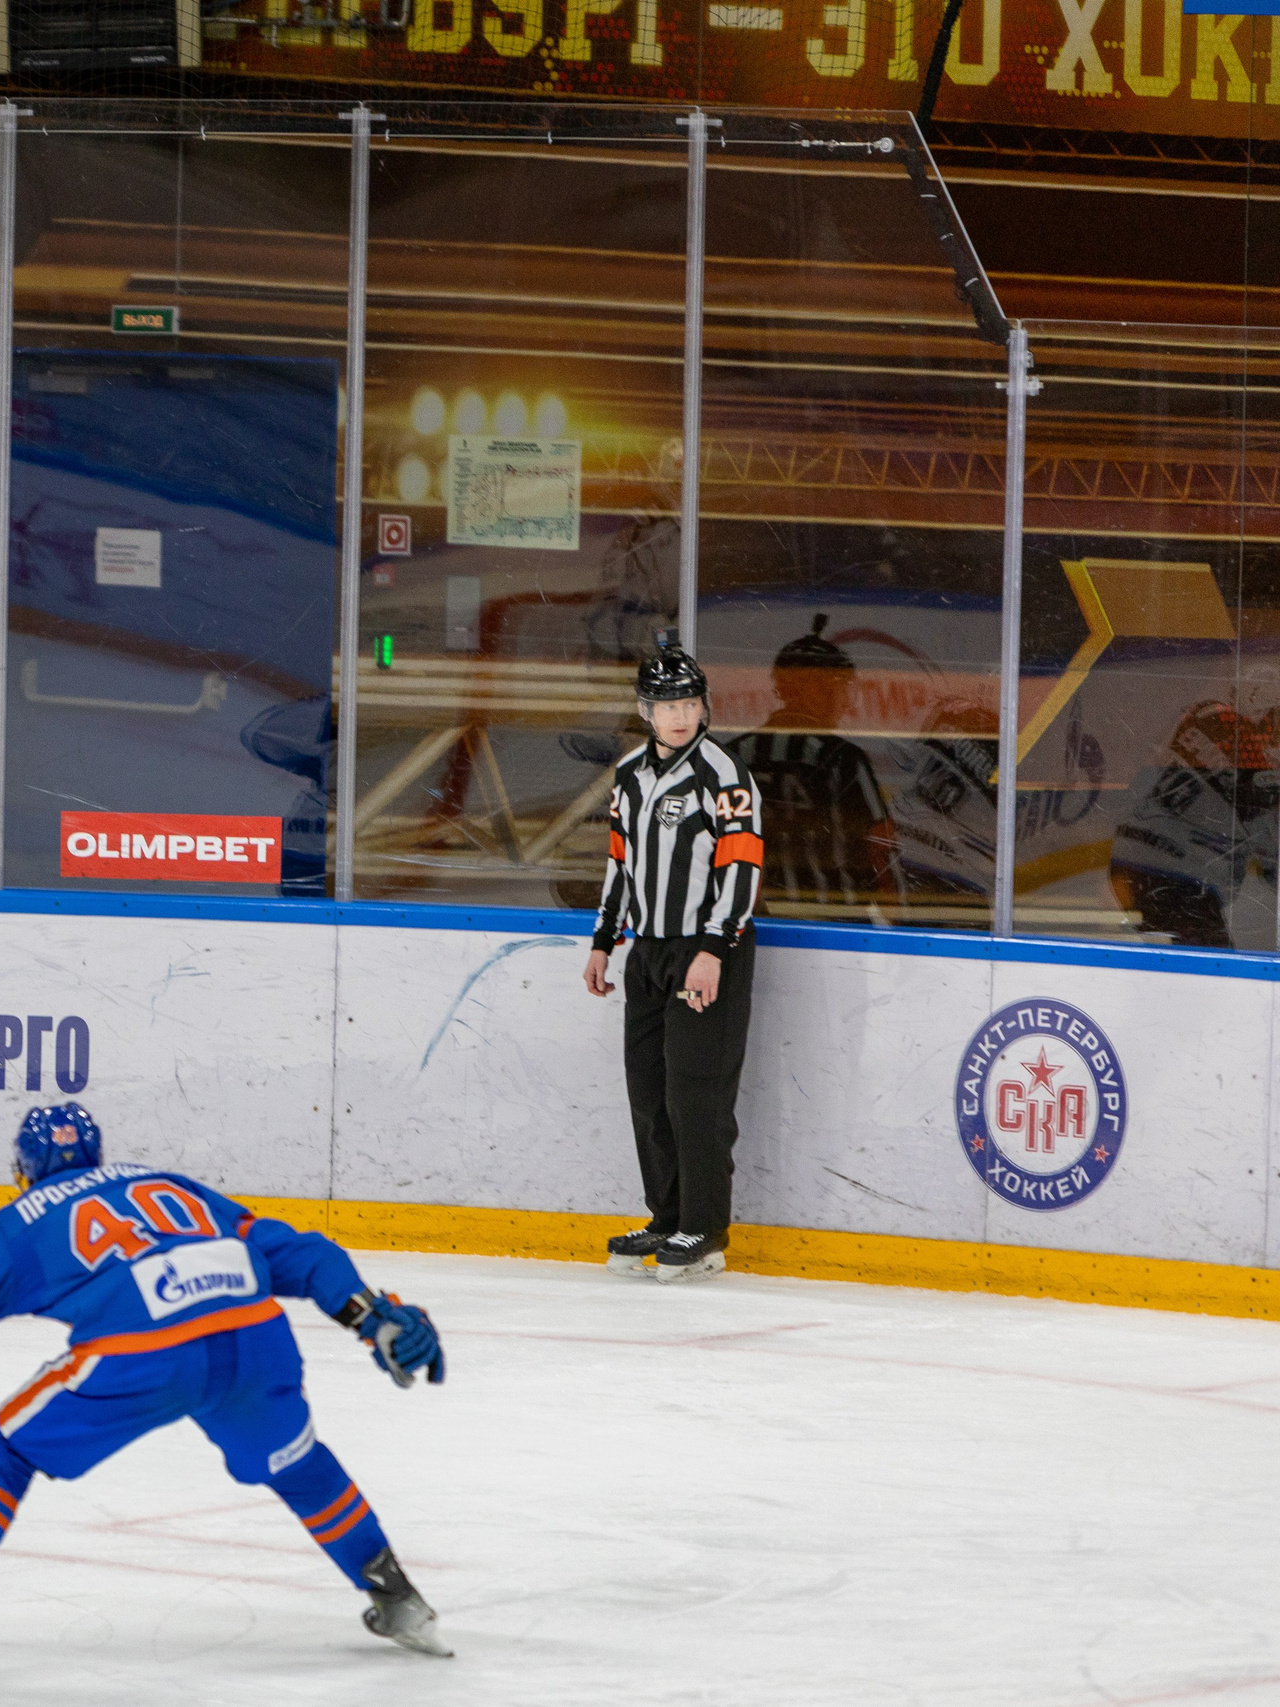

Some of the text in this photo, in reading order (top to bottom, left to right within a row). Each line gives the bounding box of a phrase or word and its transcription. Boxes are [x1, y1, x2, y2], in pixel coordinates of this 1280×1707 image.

[610, 787, 620, 819] 2
[716, 788, 753, 820] 42
[66, 831, 275, 863] OLIMPBET
[962, 1007, 1120, 1132] САНКТ-ПЕТЕРБУРГ
[996, 1079, 1088, 1154] СКА
[987, 1158, 1091, 1202] ХОККЕЙ
[68, 1178, 223, 1273] 40
